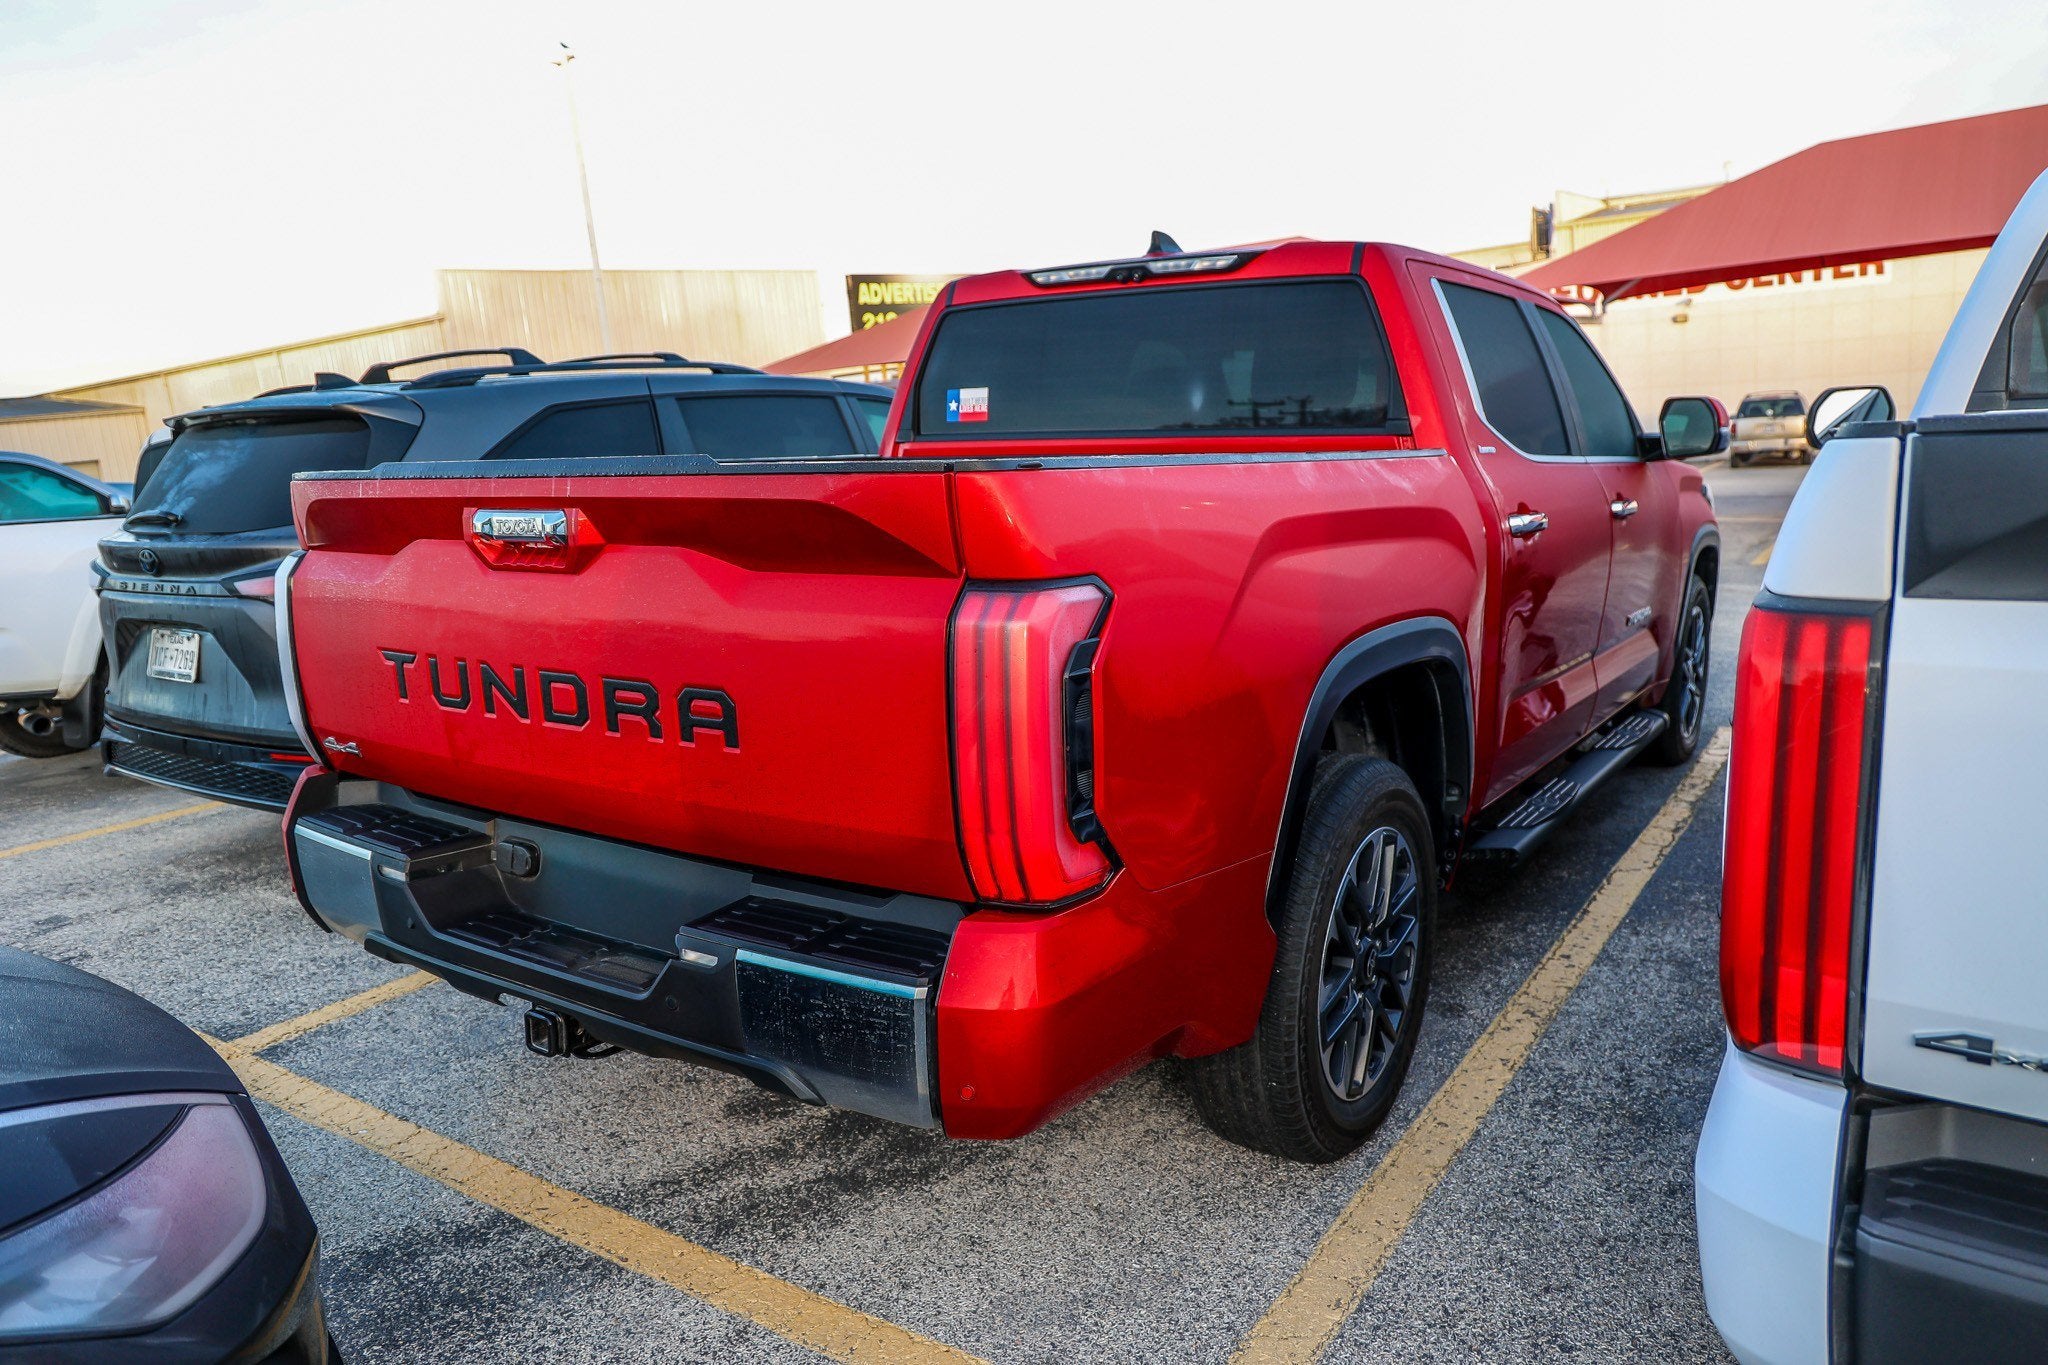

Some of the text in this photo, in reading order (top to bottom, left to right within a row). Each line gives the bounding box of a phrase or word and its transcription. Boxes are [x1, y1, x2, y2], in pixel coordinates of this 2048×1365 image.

[858, 282, 945, 305] ADVERTIS
[496, 518, 540, 535] TOYOTA
[120, 581, 197, 595] SIENNA
[378, 648, 740, 750] TUNDRA
[1913, 1029, 2048, 1073] 4x
